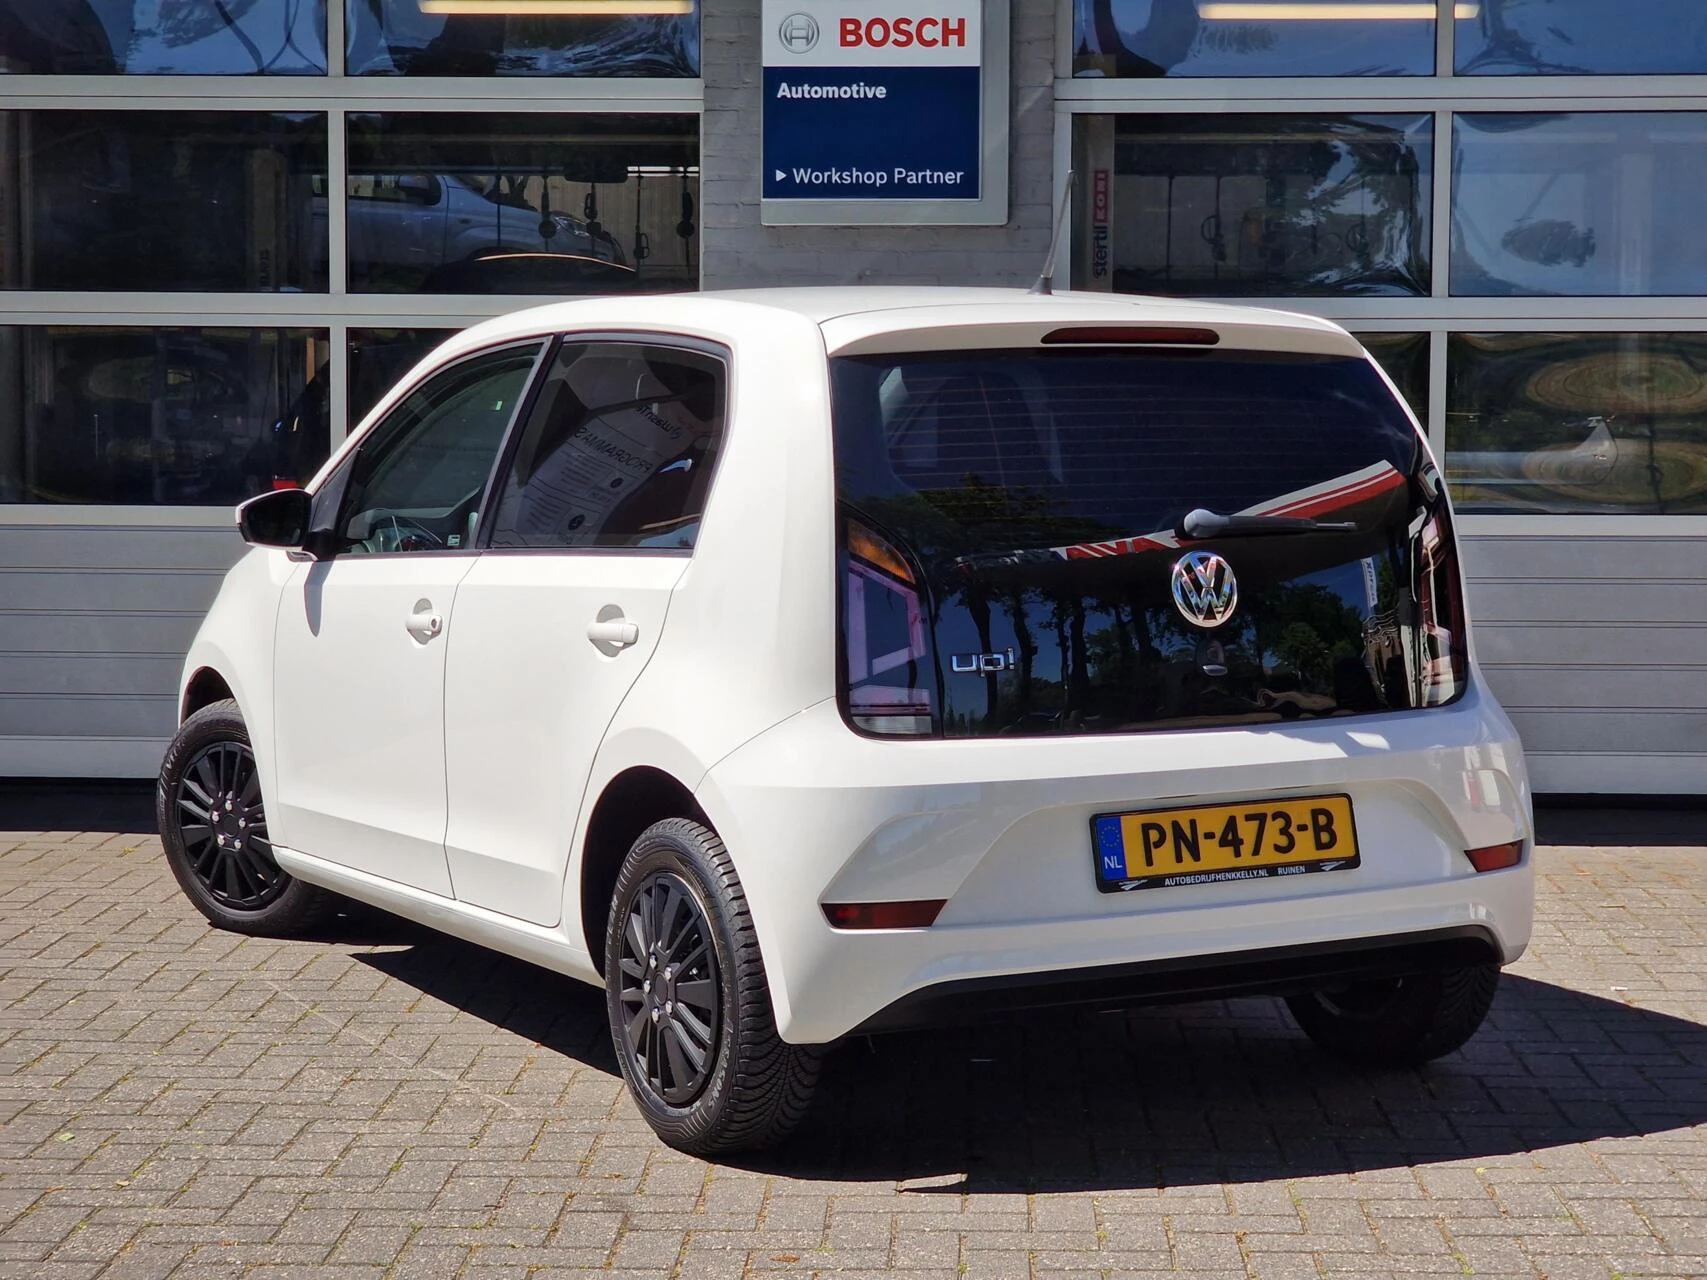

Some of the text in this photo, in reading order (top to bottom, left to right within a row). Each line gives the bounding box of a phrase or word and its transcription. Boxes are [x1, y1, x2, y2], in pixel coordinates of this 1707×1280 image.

[839, 17, 965, 48] BOSCH
[777, 82, 887, 99] Automotive
[793, 168, 964, 187] Workshop Partner
[1141, 808, 1338, 867] PN-473-B
[1104, 855, 1123, 870] NL
[1277, 865, 1306, 875] RUINEN
